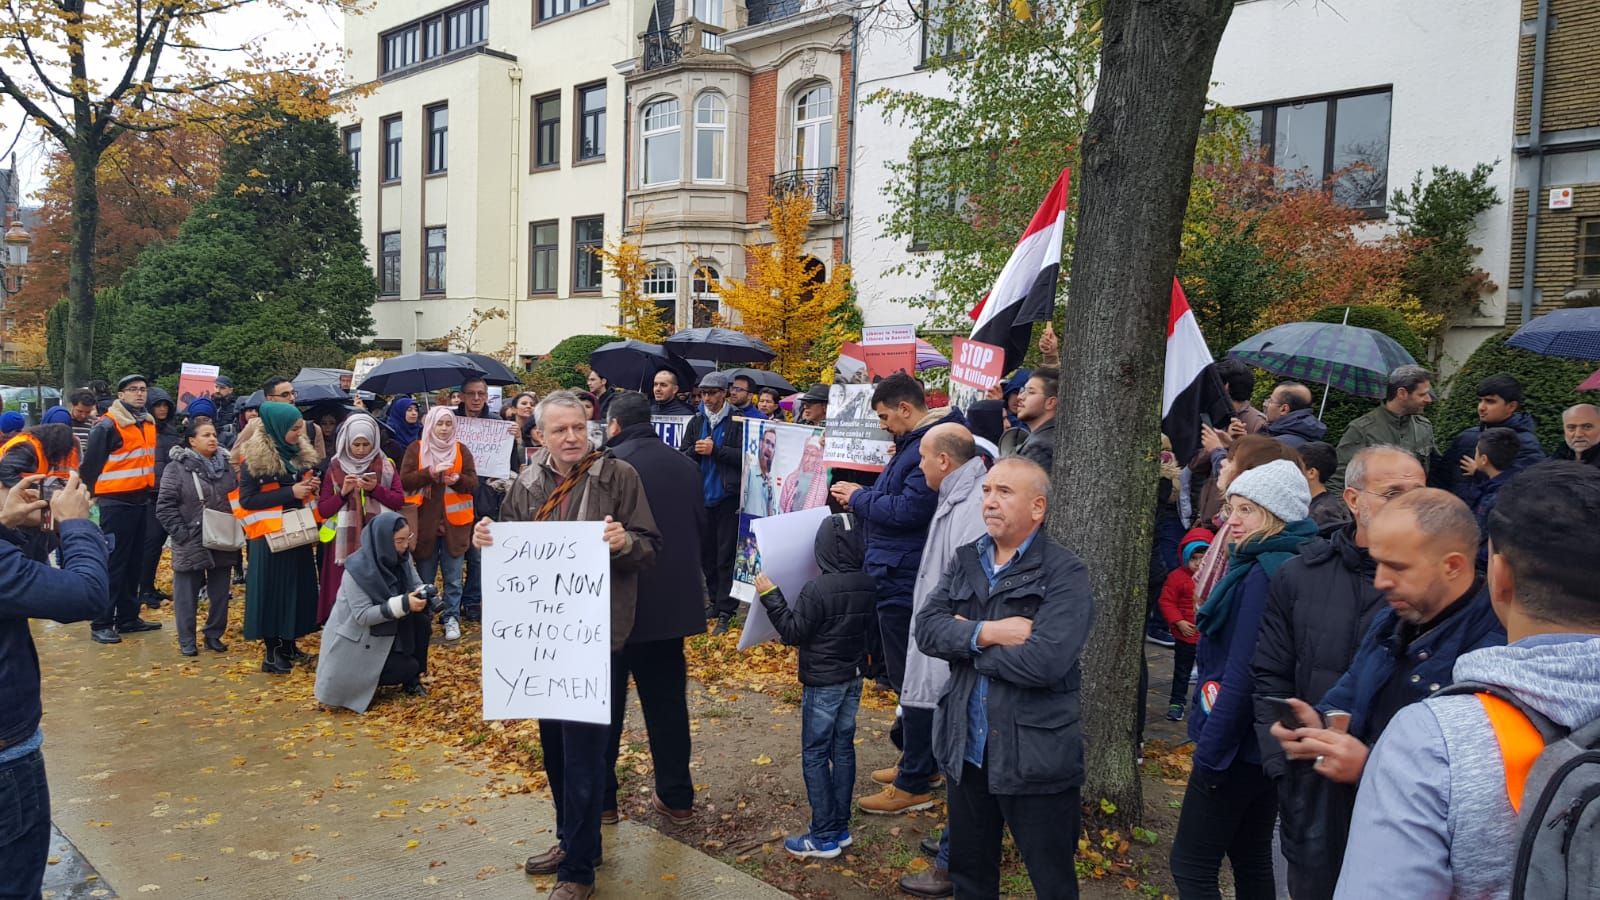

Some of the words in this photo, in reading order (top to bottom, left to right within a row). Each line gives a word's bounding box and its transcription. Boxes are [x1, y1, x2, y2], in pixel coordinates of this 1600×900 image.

[961, 342, 993, 370] STOP
[963, 367, 998, 389] Killing!
[502, 535, 577, 563] SAUDIS
[496, 574, 539, 593] STOP
[555, 572, 604, 597] NOW
[528, 599, 566, 614] THE
[491, 619, 603, 645] GENOCIDE
[534, 641, 557, 661] IN
[495, 662, 608, 707] YEMEN!
